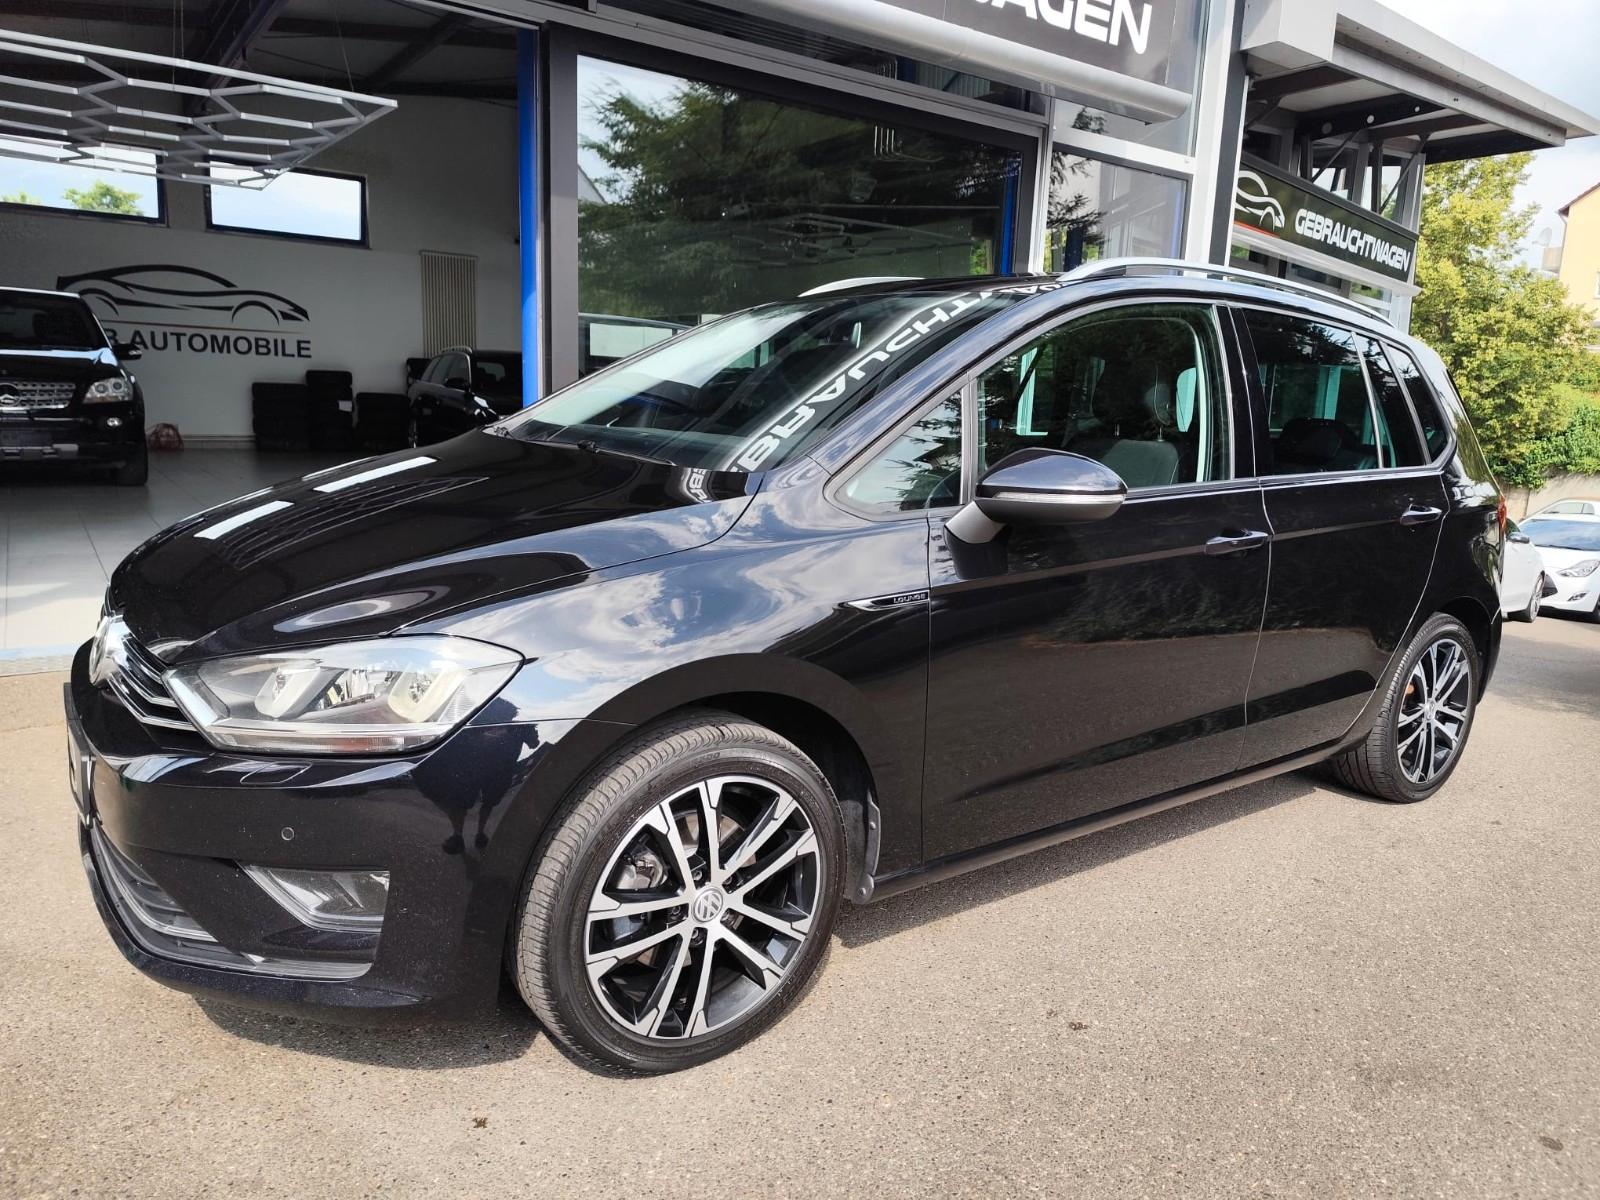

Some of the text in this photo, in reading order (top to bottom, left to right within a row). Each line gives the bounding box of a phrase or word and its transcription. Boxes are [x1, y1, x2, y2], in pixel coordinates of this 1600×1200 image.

[1295, 208, 1411, 272] GEBRAUCHTWAGEN
[129, 329, 312, 358] AUTOMOBILE
[893, 593, 926, 604] LOUNGE
